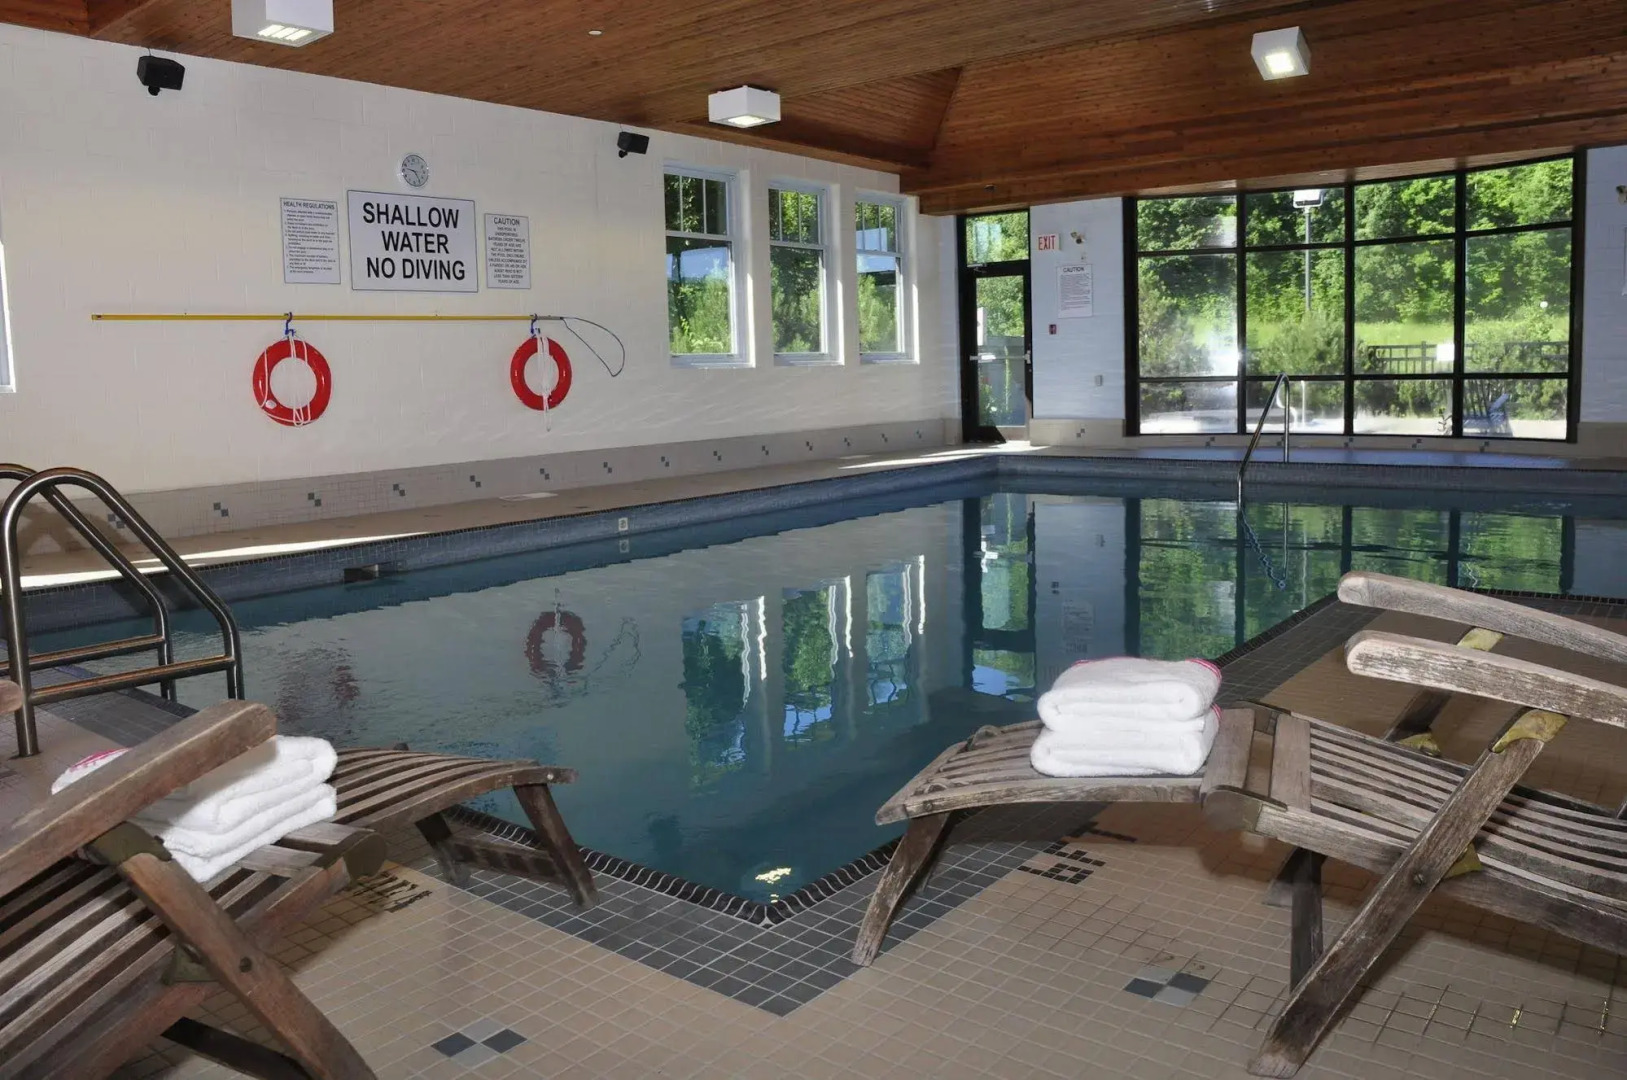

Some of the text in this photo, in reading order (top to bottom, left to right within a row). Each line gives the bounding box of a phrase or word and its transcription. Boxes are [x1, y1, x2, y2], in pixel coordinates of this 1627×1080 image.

[303, 202, 335, 210] REGULATIONS
[363, 202, 459, 228] SHALLOW
[494, 217, 520, 225] CAUTION
[381, 231, 449, 254] WATER
[1038, 235, 1056, 251] EXIT
[367, 257, 465, 280] NO DIVING
